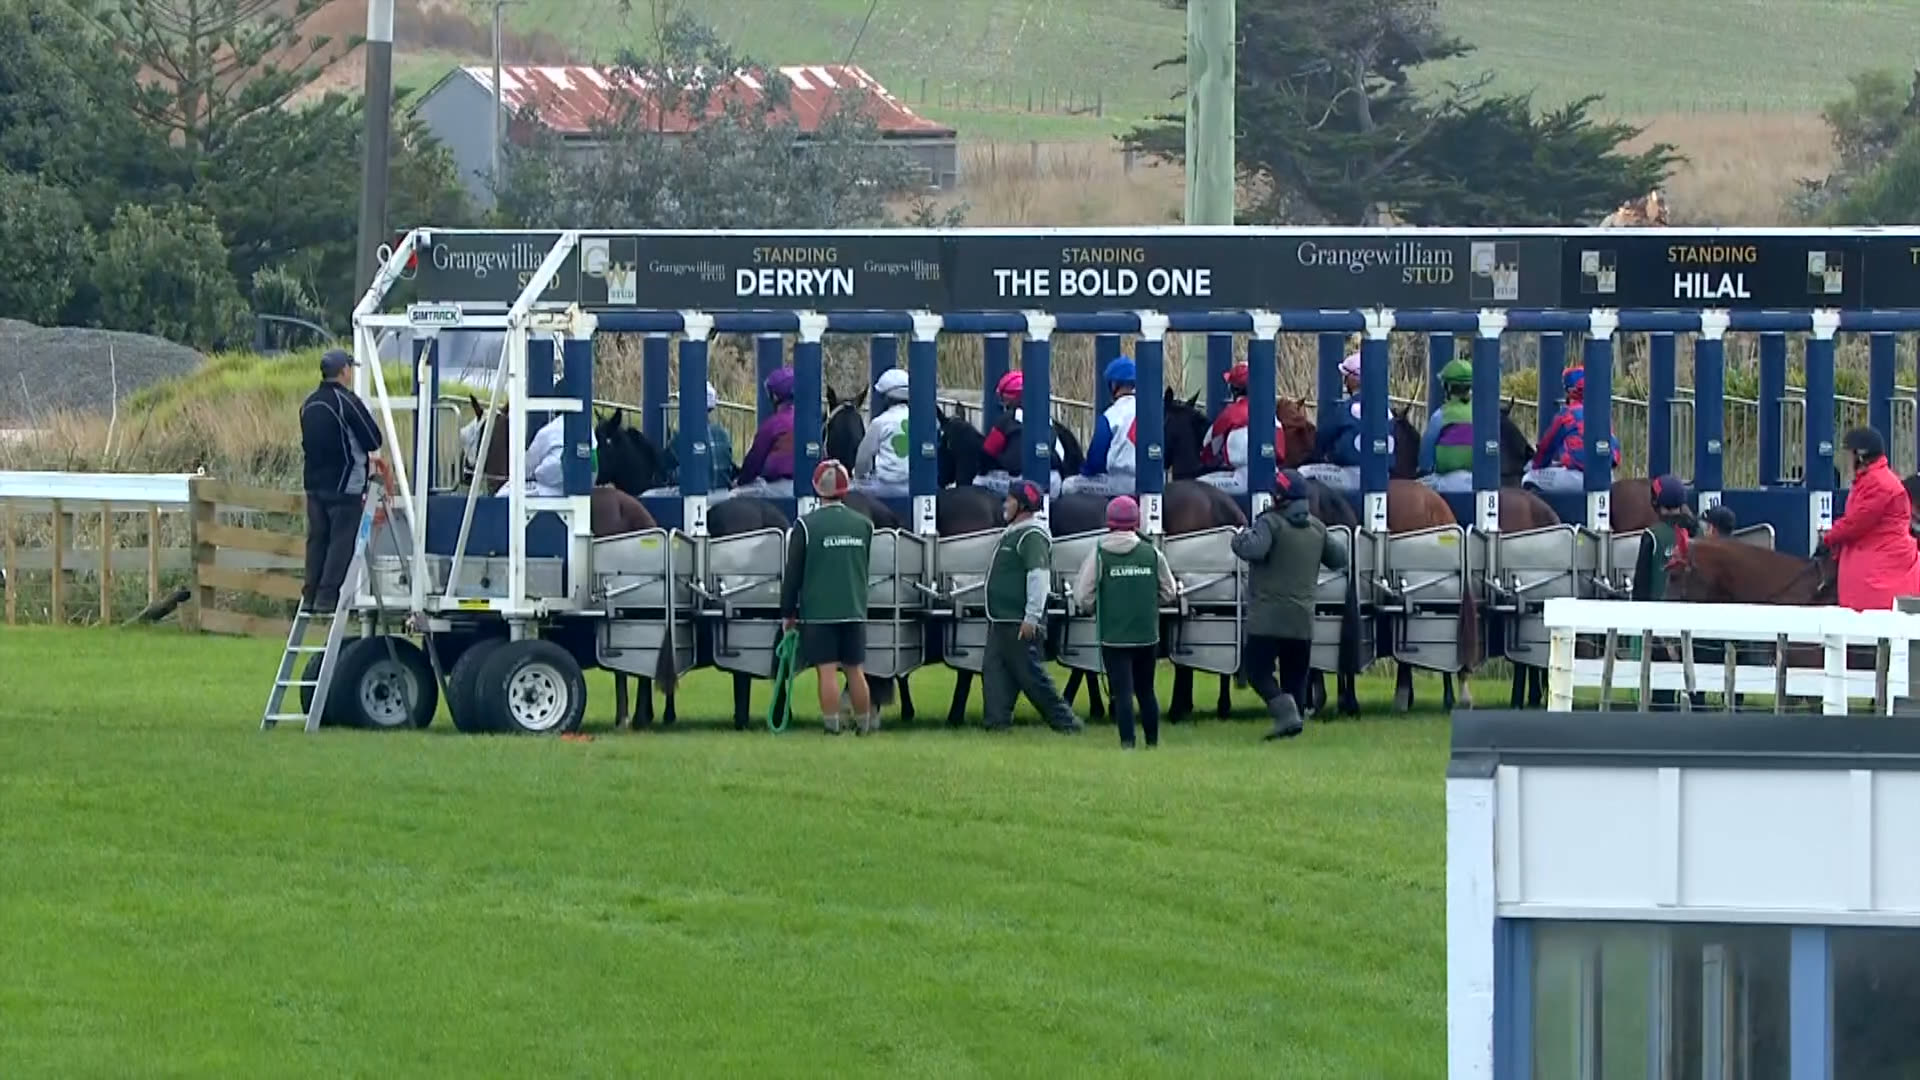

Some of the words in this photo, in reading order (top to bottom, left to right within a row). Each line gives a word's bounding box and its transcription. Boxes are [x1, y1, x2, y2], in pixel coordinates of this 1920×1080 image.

[432, 243, 547, 278] Grangewillia
[753, 247, 837, 263] STANDING
[1062, 247, 1145, 263] STANDING
[1297, 241, 1453, 274] Grangewilliam
[1667, 246, 1757, 263] STANDING
[649, 260, 725, 276] Grangewilliam
[864, 260, 940, 276] Grangewilliam
[915, 272, 940, 280] STUD
[1402, 267, 1454, 284] STUD
[518, 271, 560, 290] SD
[701, 273, 726, 281] STUD
[736, 268, 854, 296] DERRYN
[993, 268, 1050, 297] THE
[1060, 268, 1138, 297] BOLD
[1147, 268, 1211, 297] ONE
[1673, 272, 1751, 298] HILAL
[412, 311, 457, 321] SIMTRACK
[924, 499, 931, 512] 3
[1151, 499, 1158, 512] 5
[1375, 497, 1383, 511] 7
[1488, 496, 1495, 509] 8
[1599, 496, 1606, 509] 9
[1820, 497, 1830, 511] 11
[696, 505, 701, 518] 1
